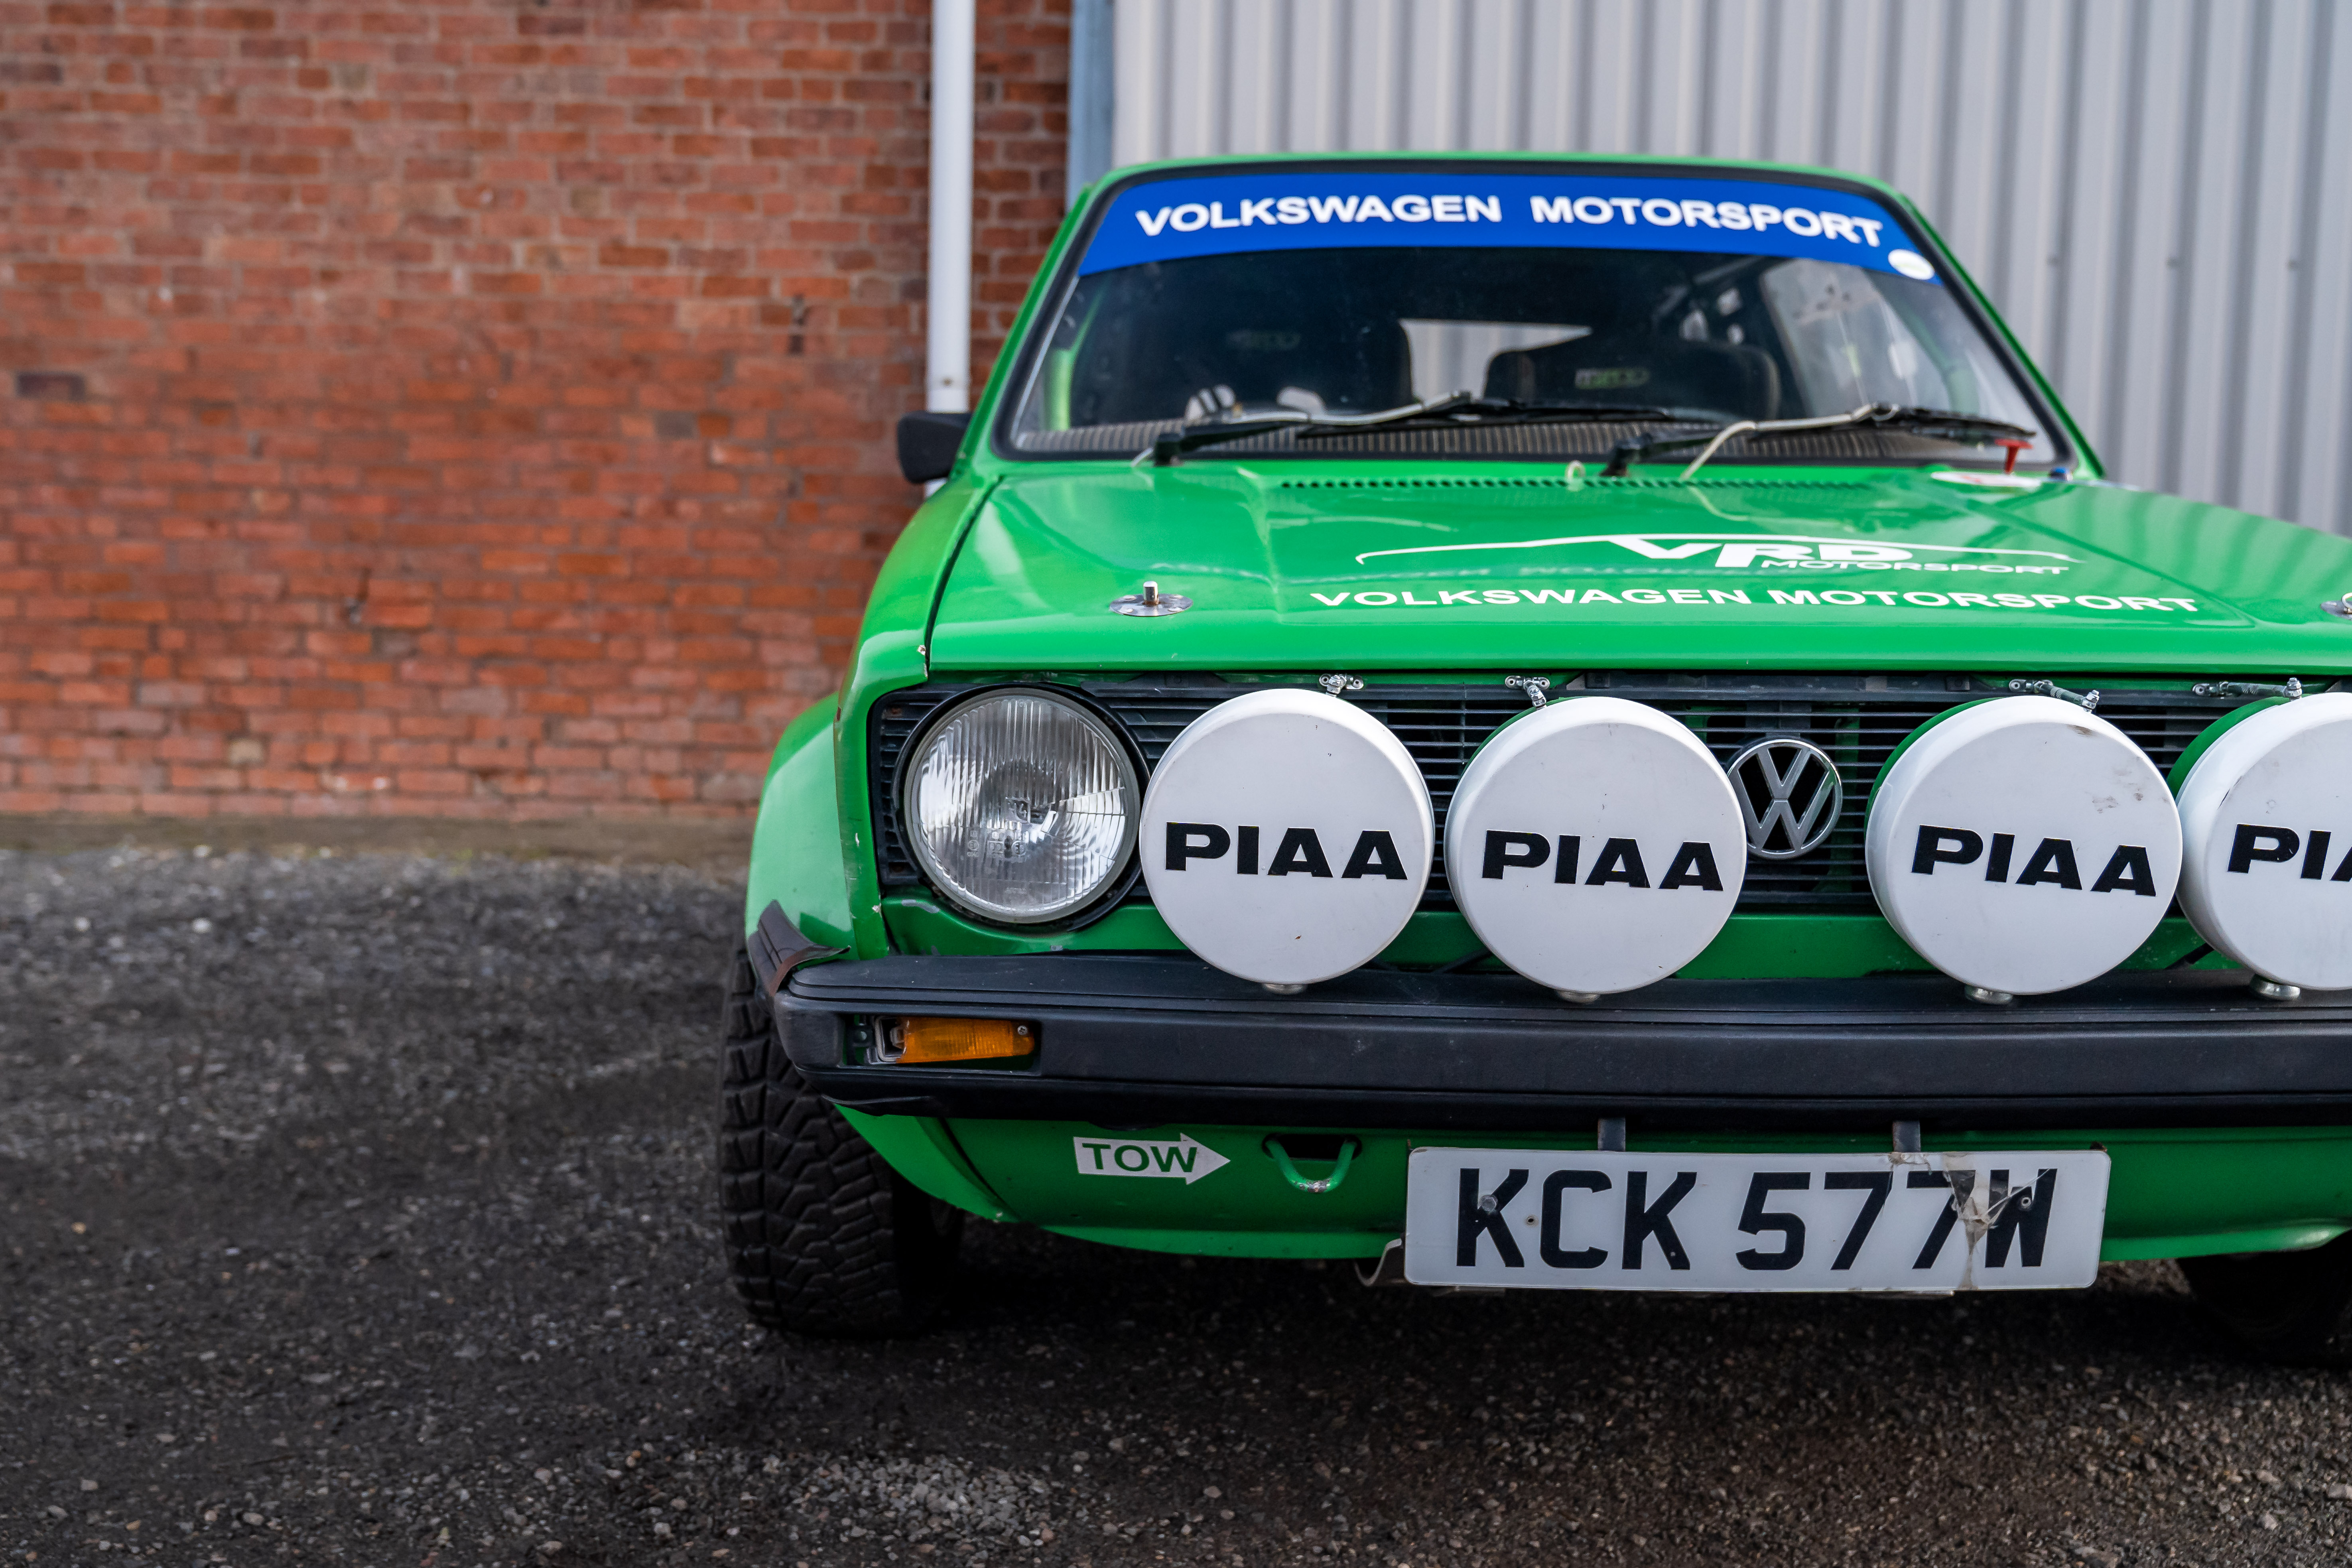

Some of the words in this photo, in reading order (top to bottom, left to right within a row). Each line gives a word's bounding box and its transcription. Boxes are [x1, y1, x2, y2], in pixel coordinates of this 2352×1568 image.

[1136, 195, 1502, 236] VOLKSWAGEN
[1530, 196, 1883, 248] MOTORSPORT
[1607, 535, 1913, 567] VRD
[1761, 560, 2070, 575] MOTORSPORT
[1310, 589, 1752, 606] VOLKSWAGEN
[1767, 590, 2198, 612] MOTORSPORT
[1731, 744, 1837, 854] VW
[1165, 821, 1408, 881] PIAA
[1481, 829, 1724, 892] PIAA
[1911, 824, 2157, 897] PIAA
[1082, 1143, 1197, 1172] TOW
[1456, 1168, 1698, 1271] KCK
[1735, 1168, 2058, 1271] 577W
